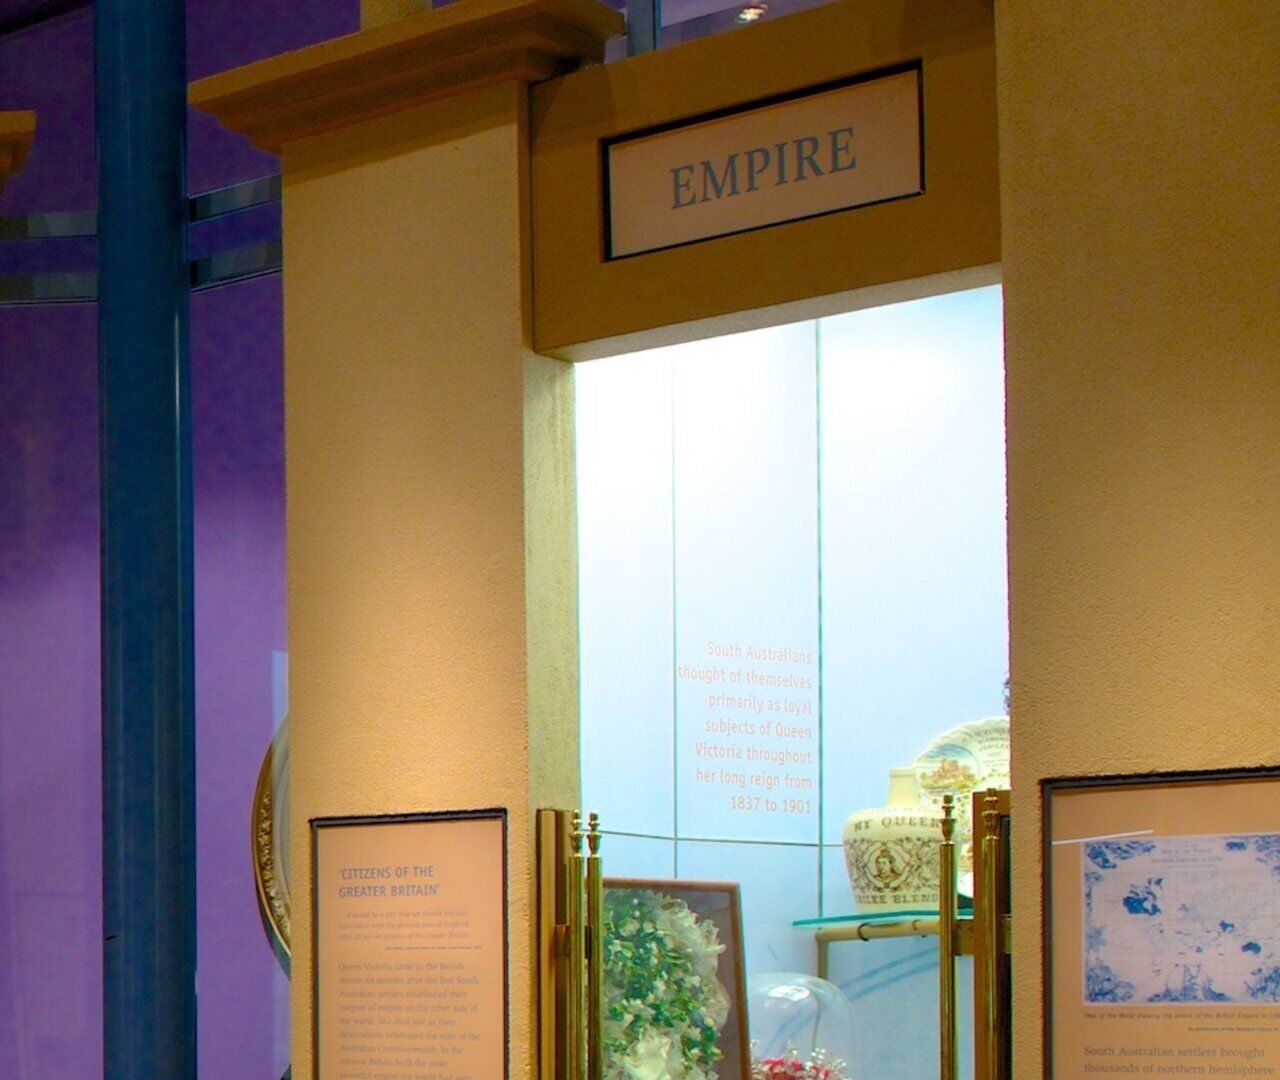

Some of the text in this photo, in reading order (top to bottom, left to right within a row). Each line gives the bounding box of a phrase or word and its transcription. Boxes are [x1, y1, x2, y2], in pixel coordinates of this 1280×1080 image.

[670, 127, 857, 210] EMPIRE
[707, 640, 812, 664] South Australians
[678, 665, 812, 690] thought of themselves
[708, 693, 812, 717] primarily as loyal
[705, 718, 812, 739] subjects of Queen
[694, 741, 812, 765] Victoria throughout
[696, 768, 812, 790] her long reign from
[730, 796, 811, 814] 1837 to 1901
[395, 866, 409, 878] OF
[413, 866, 434, 878] THE
[339, 886, 387, 899] GREATER
[1084, 1046, 1115, 1057] South
[1220, 1047, 1265, 1061] brought
[1084, 1064, 1274, 1078] thousands of northern hemisphere
